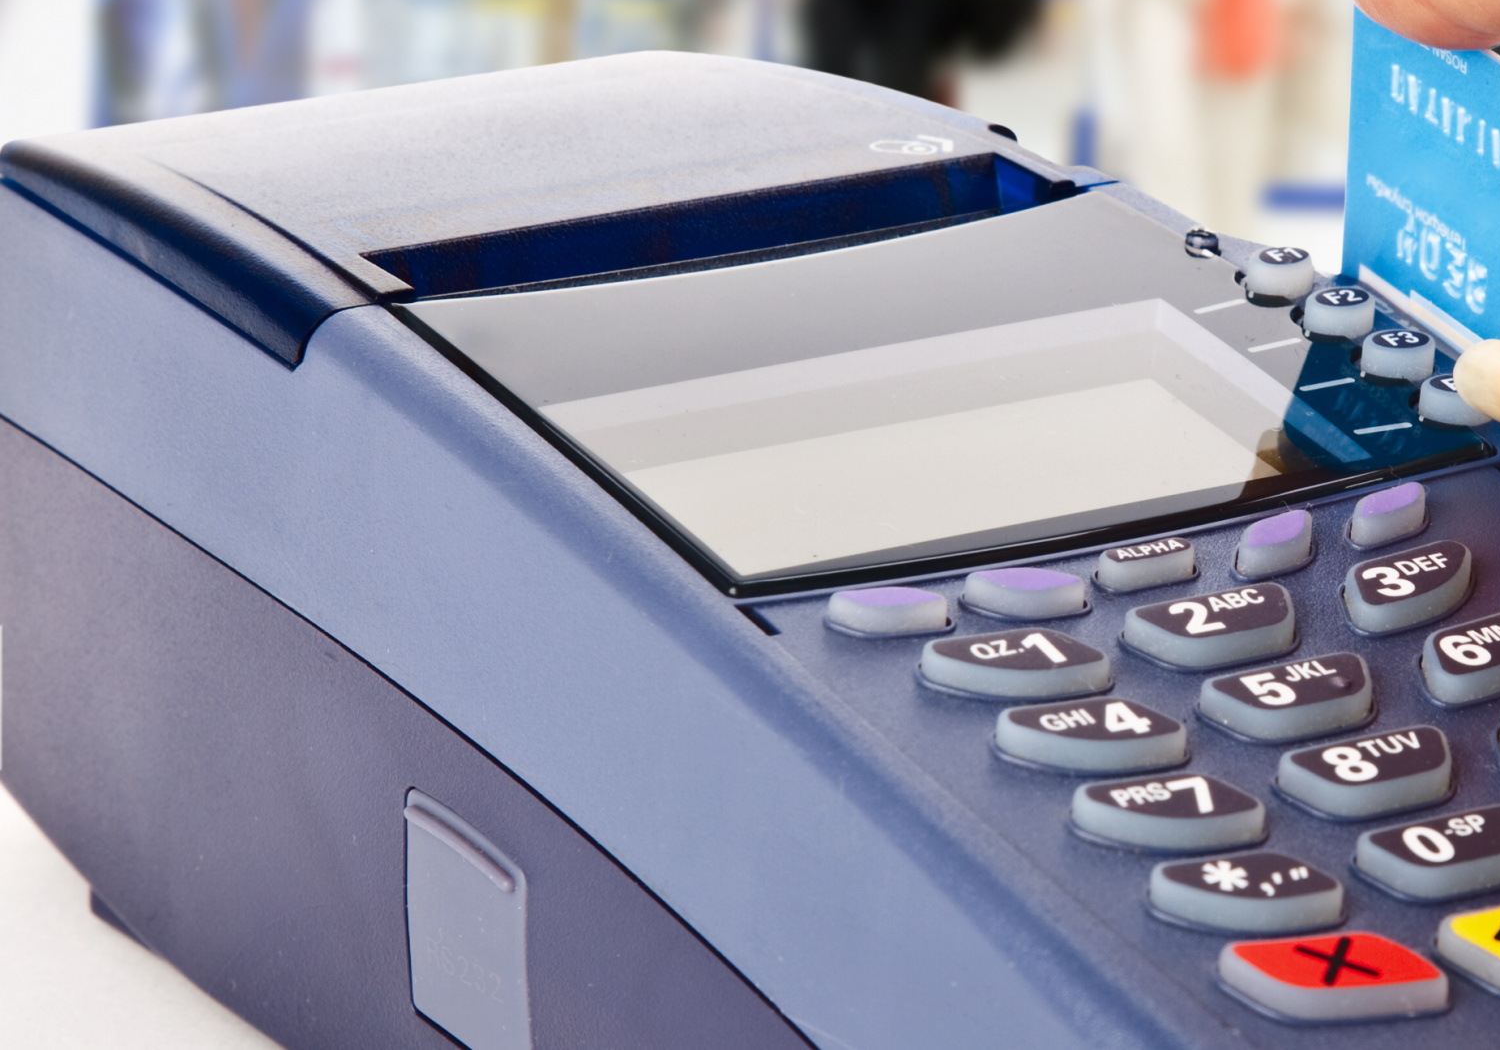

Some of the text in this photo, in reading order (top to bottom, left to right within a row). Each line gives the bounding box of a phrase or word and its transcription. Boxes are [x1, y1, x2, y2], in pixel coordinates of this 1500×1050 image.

[1265, 247, 1304, 262] F1
[1322, 289, 1363, 305] F2
[1380, 331, 1420, 347] F3
[1115, 537, 1185, 561] ALPHA
[1361, 552, 1448, 598] 3 DEF
[1168, 587, 1265, 635] 2 ABC
[1020, 632, 1068, 664] 1
[1439, 634, 1492, 666] 6
[1239, 660, 1337, 706] 5 JKL
[1039, 701, 1152, 735] GHI 4
[1321, 731, 1421, 782] 8 TUV
[1109, 775, 1215, 814] PRS 7
